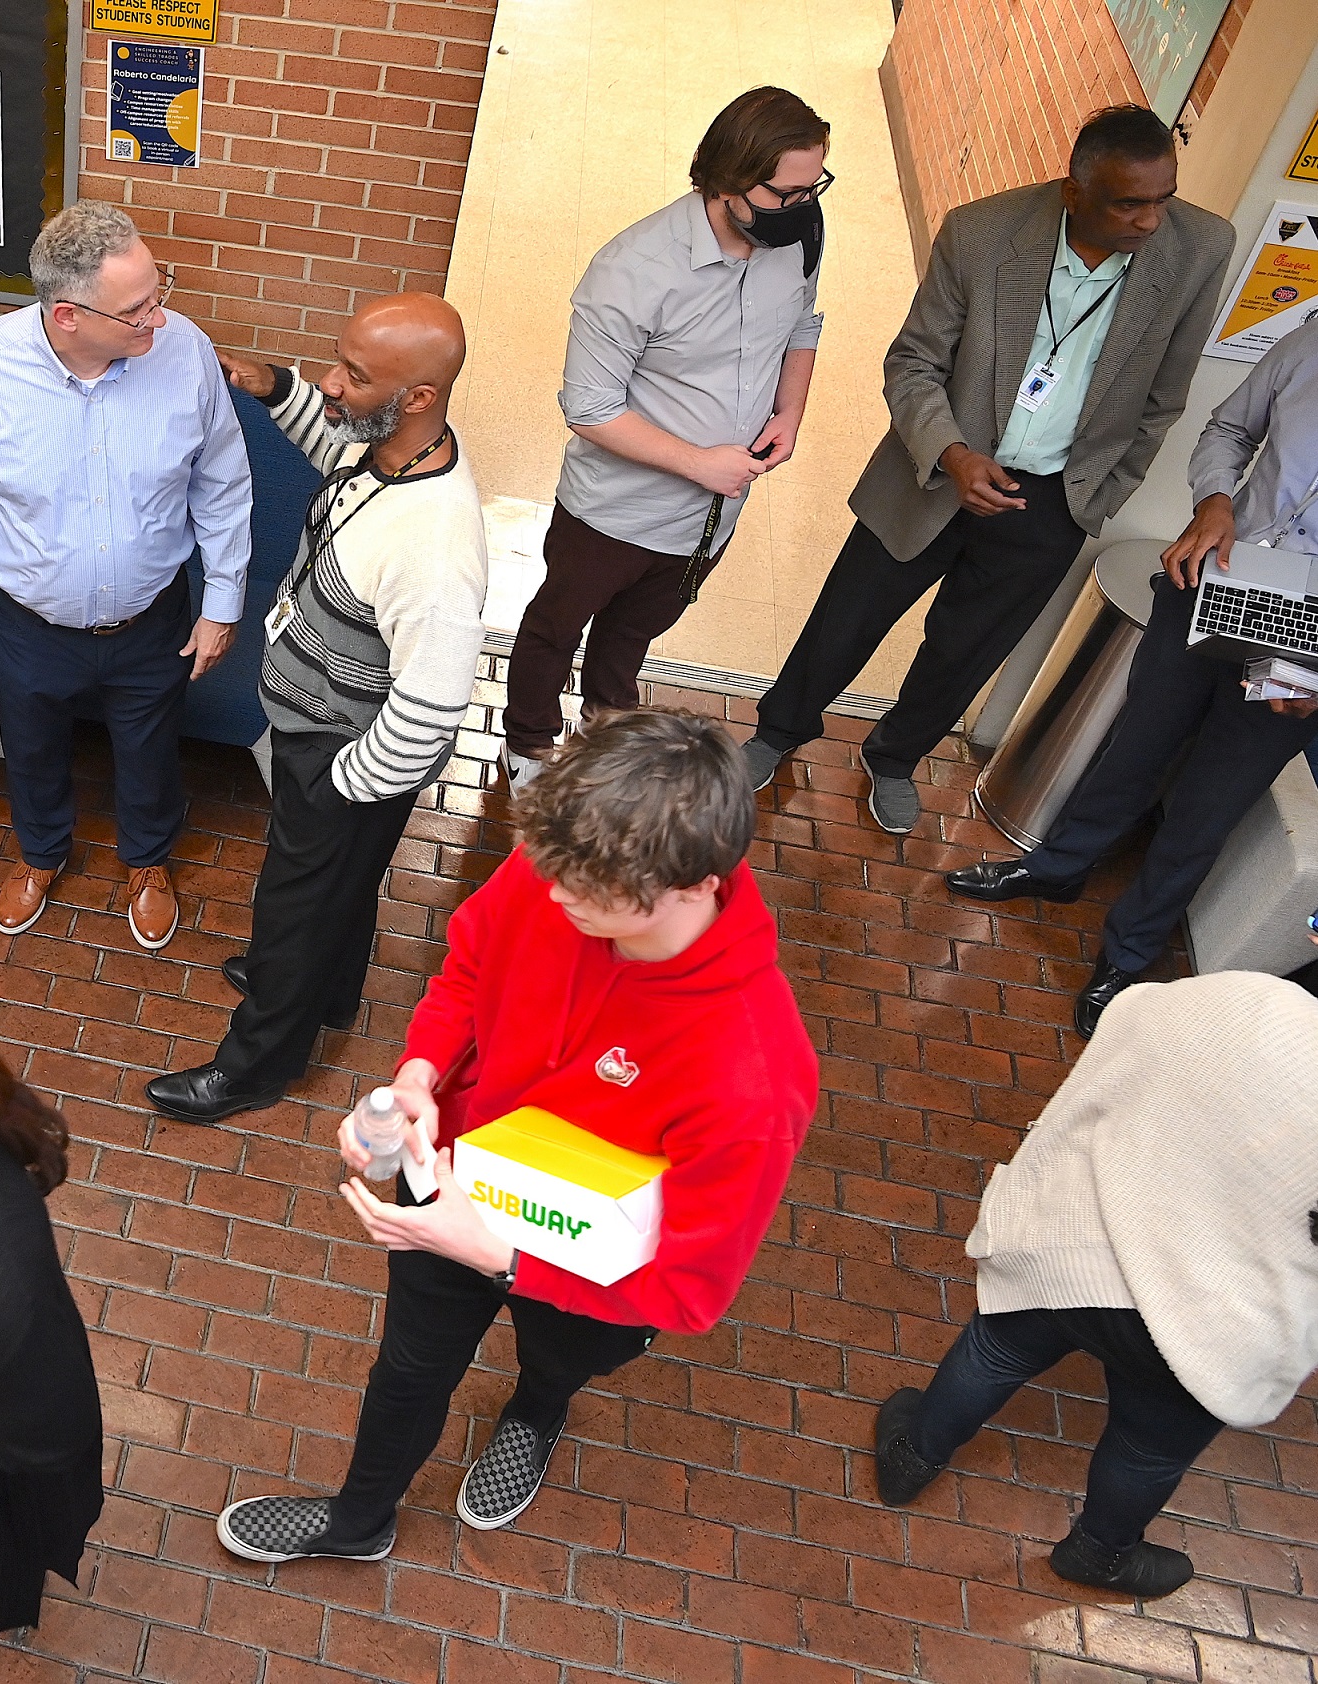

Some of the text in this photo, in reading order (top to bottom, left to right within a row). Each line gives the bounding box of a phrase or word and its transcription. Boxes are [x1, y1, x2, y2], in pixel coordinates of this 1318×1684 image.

[151, 0, 201, 14] RESPECT
[96, 8, 210, 30] STUDENTS STUDYING
[113, 69, 197, 84] Roberto Candelaria
[469, 1180, 592, 1240] SUBWAY
